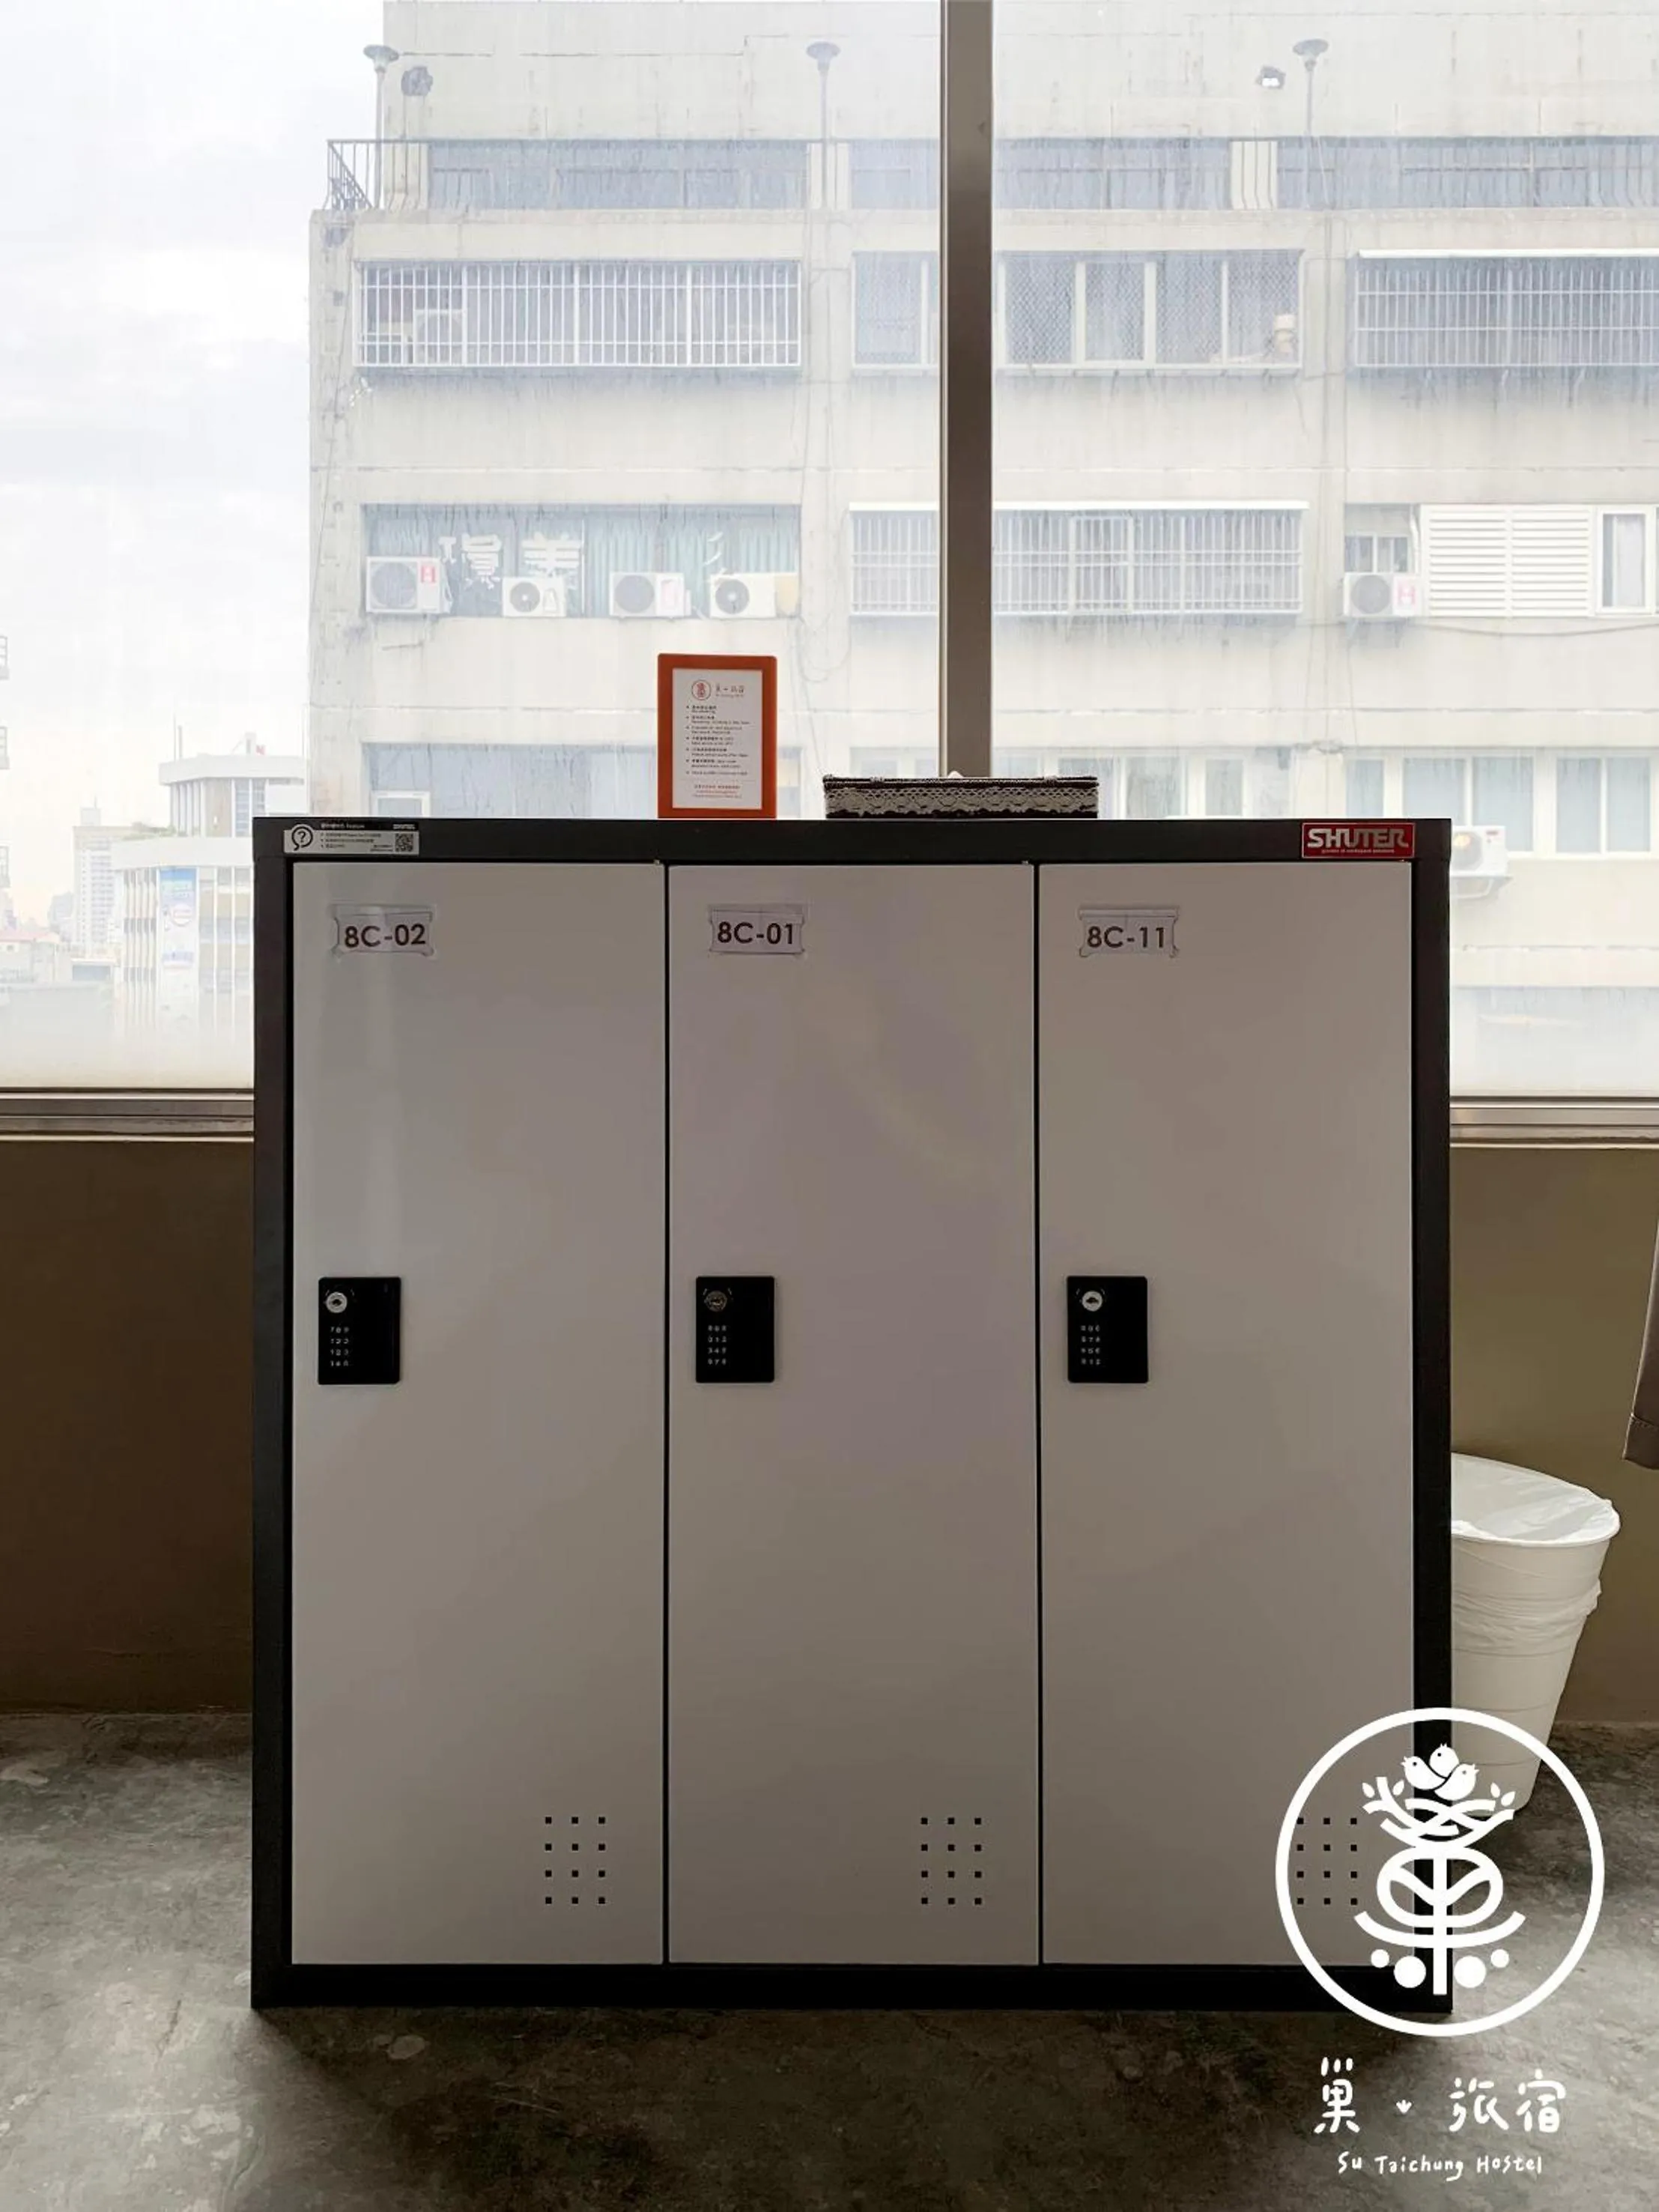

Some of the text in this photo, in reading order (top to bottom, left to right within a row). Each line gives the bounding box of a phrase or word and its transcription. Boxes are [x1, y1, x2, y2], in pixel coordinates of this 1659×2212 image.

[1306, 828, 1410, 849] SHUTER
[344, 923, 426, 948] 8C-02
[718, 921, 794, 945] 8C-01
[1087, 926, 1165, 948] 8C-11
